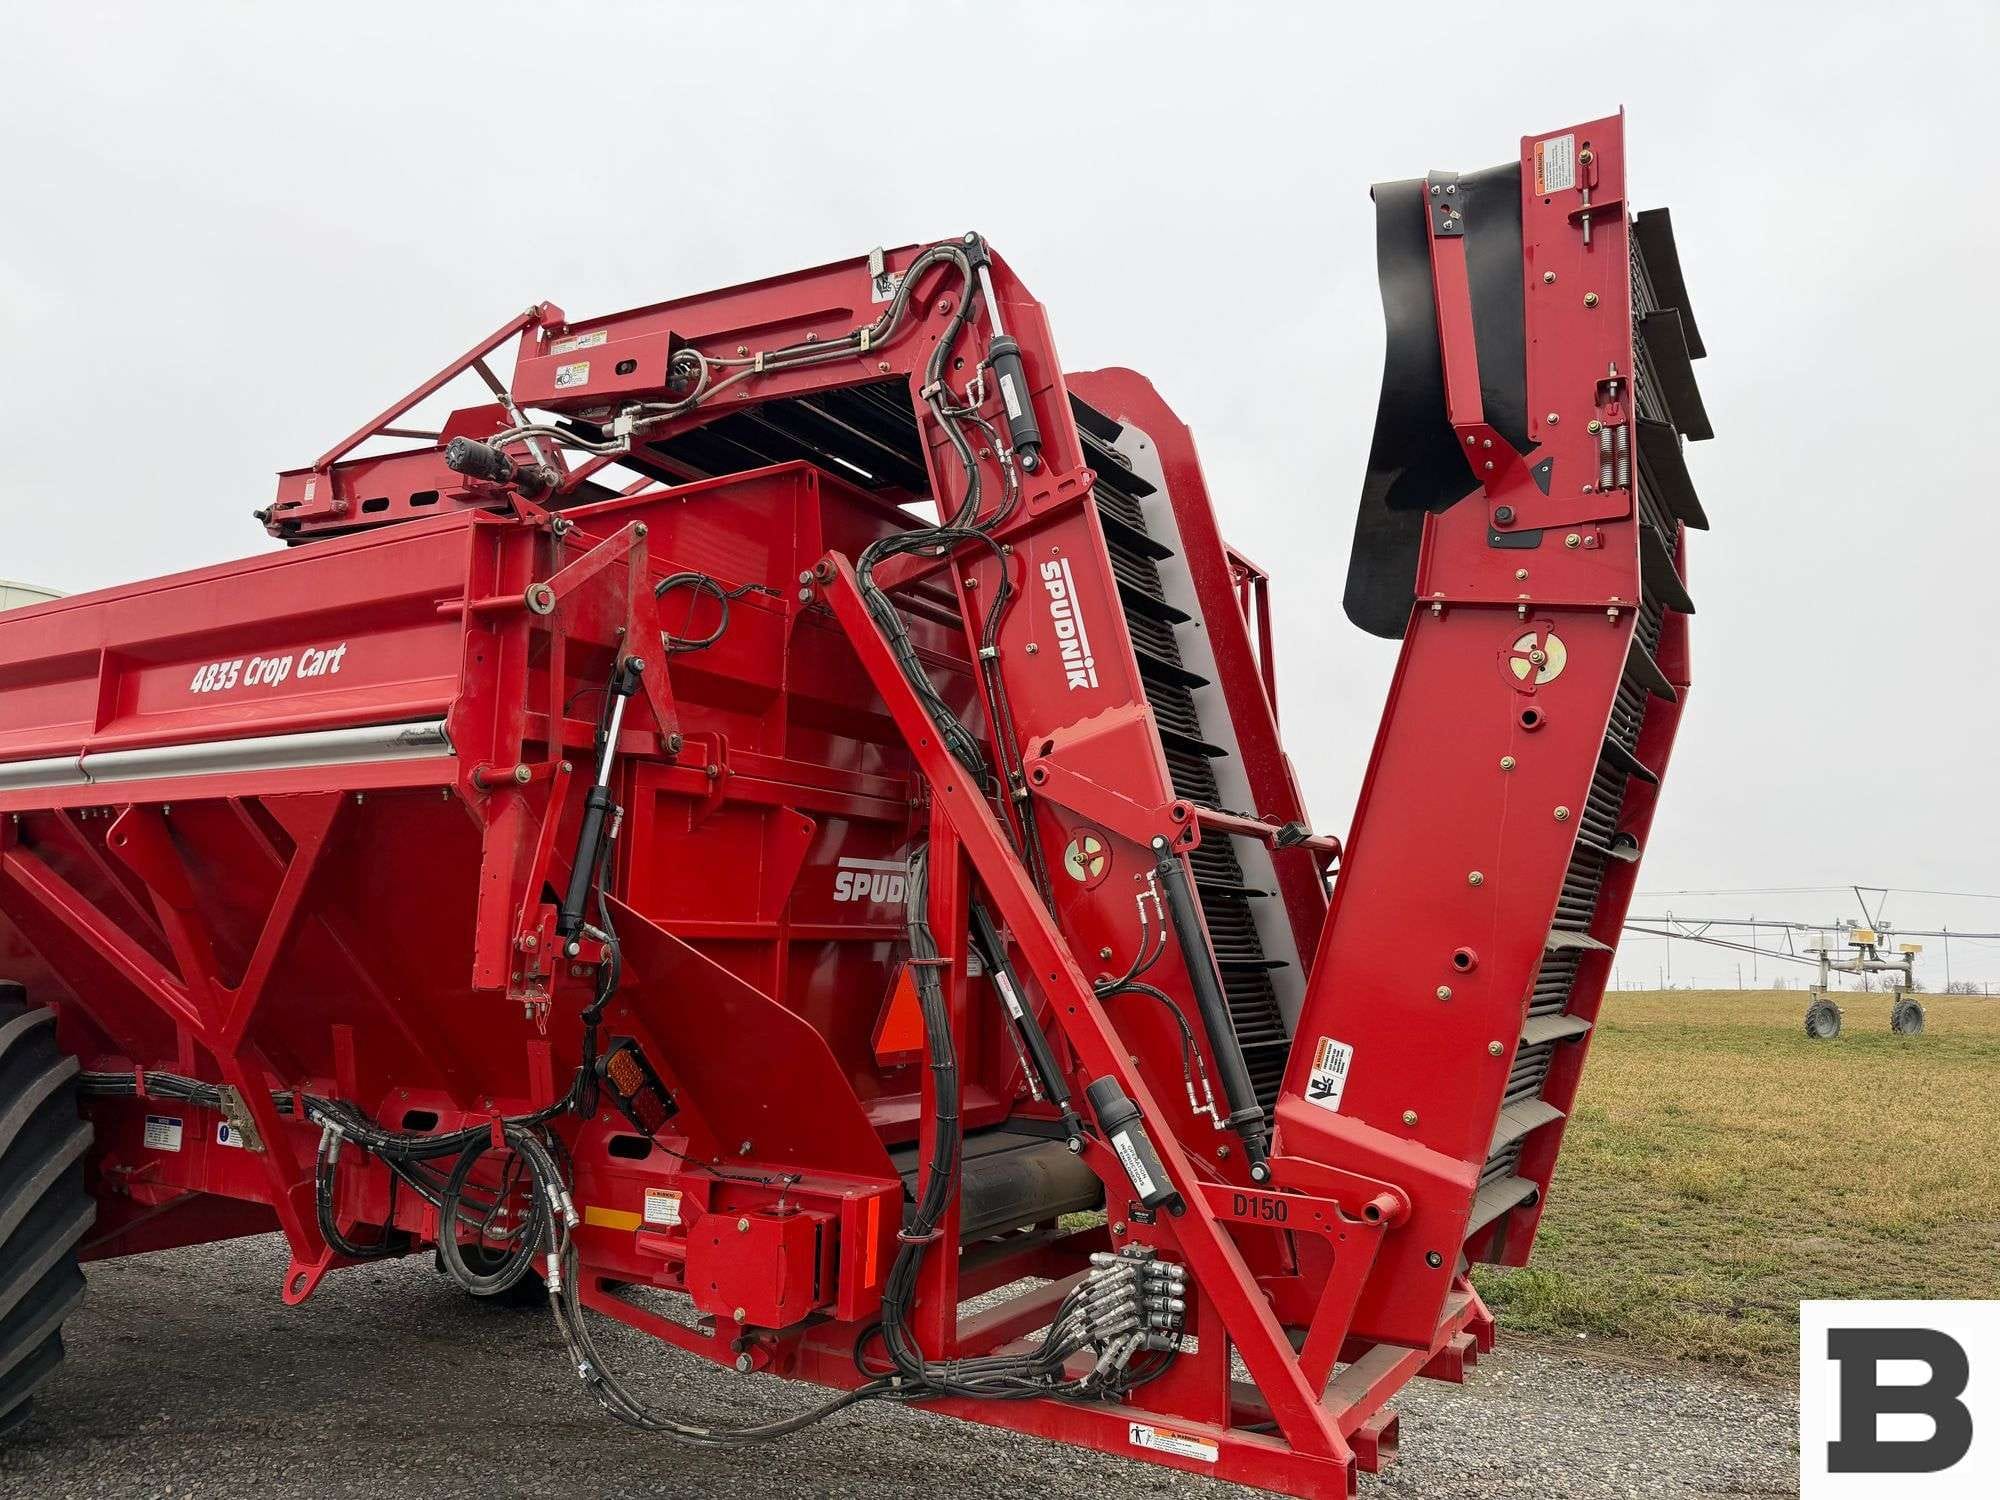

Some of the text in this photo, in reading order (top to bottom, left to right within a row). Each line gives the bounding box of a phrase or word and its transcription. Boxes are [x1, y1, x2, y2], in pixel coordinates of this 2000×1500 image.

[189, 642, 347, 693] 4835 Crop Cart
[833, 871, 908, 903] SPUD
[1120, 1143, 1145, 1187] INSTRUCTIONS
[1233, 1193, 1288, 1222] D150
